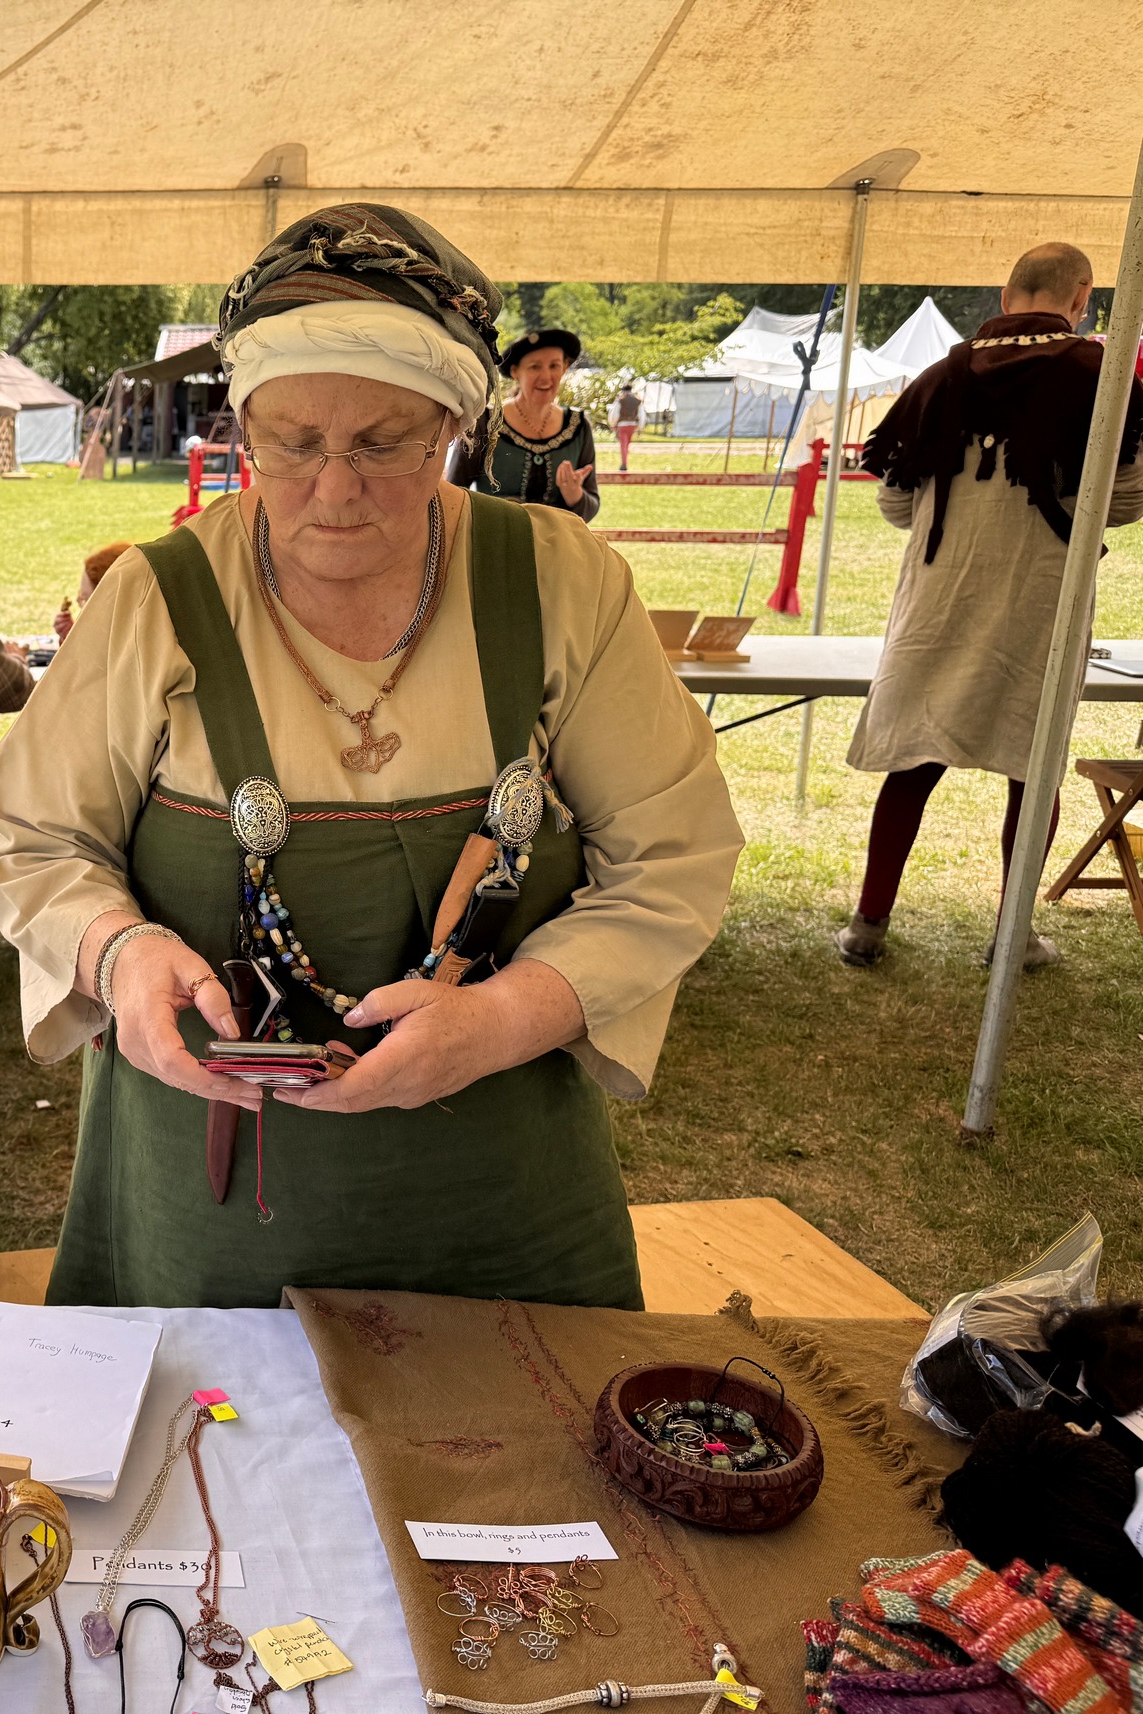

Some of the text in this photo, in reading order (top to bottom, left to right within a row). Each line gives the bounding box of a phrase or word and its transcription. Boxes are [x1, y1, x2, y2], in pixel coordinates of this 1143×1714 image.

[28, 1337, 61, 1357] Tracey
[422, 1528, 591, 1542] In this bowl, rings and pendants
[92, 1556, 174, 1571] Pdants
